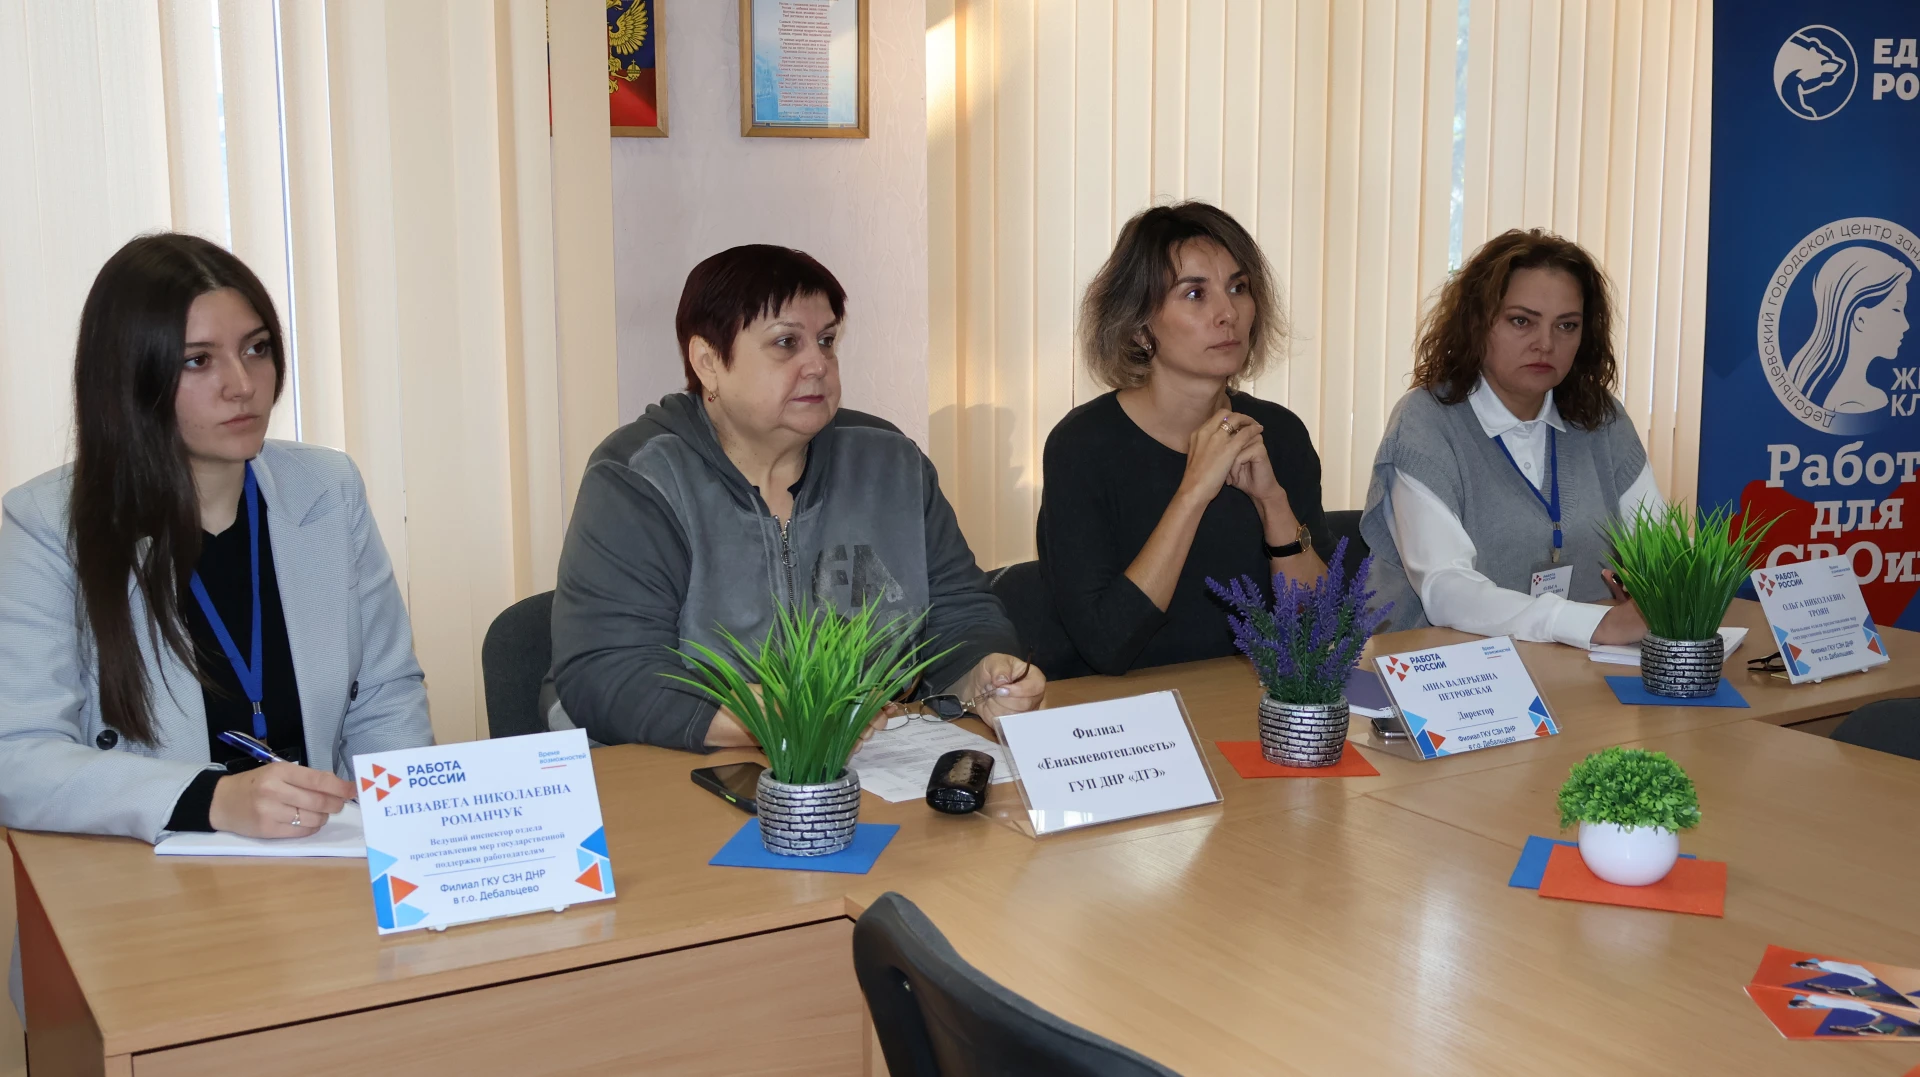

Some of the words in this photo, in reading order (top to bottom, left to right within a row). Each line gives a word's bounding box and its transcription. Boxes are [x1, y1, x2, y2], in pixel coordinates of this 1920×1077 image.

[1873, 38, 1919, 69] ЕД
[1872, 72, 1920, 101] РО
[1840, 223, 1892, 240] центр
[1895, 233, 1920, 262] зан
[1767, 227, 1835, 306] городской
[1761, 312, 1836, 428] Дебальцевский
[1890, 367, 1920, 391] Ж
[1766, 440, 1920, 488] Работ
[1810, 498, 1905, 539] для
[1775, 571, 1800, 581] РАБОТА
[1778, 578, 1804, 589] РОССИИ
[1782, 601, 1805, 611] ОЛЬГА
[1804, 593, 1846, 608] НИКОЛАЕВНА
[1808, 607, 1830, 618] ТРОЯН
[1409, 653, 1442, 665] РАБОТА
[1413, 660, 1447, 673] РОССИИ
[1422, 679, 1446, 692] АННА
[1445, 672, 1499, 689] ВАЛЕРЬЕВНА
[1438, 685, 1493, 701] ПЕТРОВСКАЯ
[1457, 707, 1495, 721] Директор
[1072, 724, 1125, 739] Филиал
[1458, 733, 1480, 742] Филиал
[1480, 730, 1491, 738] ГКУ
[1491, 727, 1504, 736] СЗН
[1504, 725, 1516, 734] ДНР
[1482, 736, 1516, 748] Дебальцево
[538, 750, 560, 758] Время
[540, 753, 587, 764] возможностей
[1037, 740, 1176, 771] «Енакиевотеплосеть»
[406, 760, 462, 776] РАБОТА
[408, 772, 466, 789] РОССИИ
[1068, 778, 1097, 793] ГУП
[1100, 773, 1125, 789] ДНР
[1128, 767, 1166, 784] «ДТЭ»
[383, 796, 470, 817] ЕЛИЗАВЕТА
[473, 783, 572, 806] НИКОЛАЕВНА
[441, 806, 523, 827] РОМАНЧУК
[430, 834, 469, 846] Ведущий
[470, 829, 514, 841] инспектор
[515, 824, 543, 834] отдела
[409, 845, 477, 861] предоставления
[479, 841, 495, 851] мер
[496, 831, 566, 848] государственной
[435, 857, 481, 869] поддержки
[483, 848, 545, 864] работодателям
[440, 881, 479, 893] Филиал
[481, 876, 500, 887] ГКУ
[502, 873, 523, 884] СЗН
[525, 869, 546, 881] ДНР
[461, 894, 477, 903] г.о.
[479, 885, 540, 902] Дебальцево
